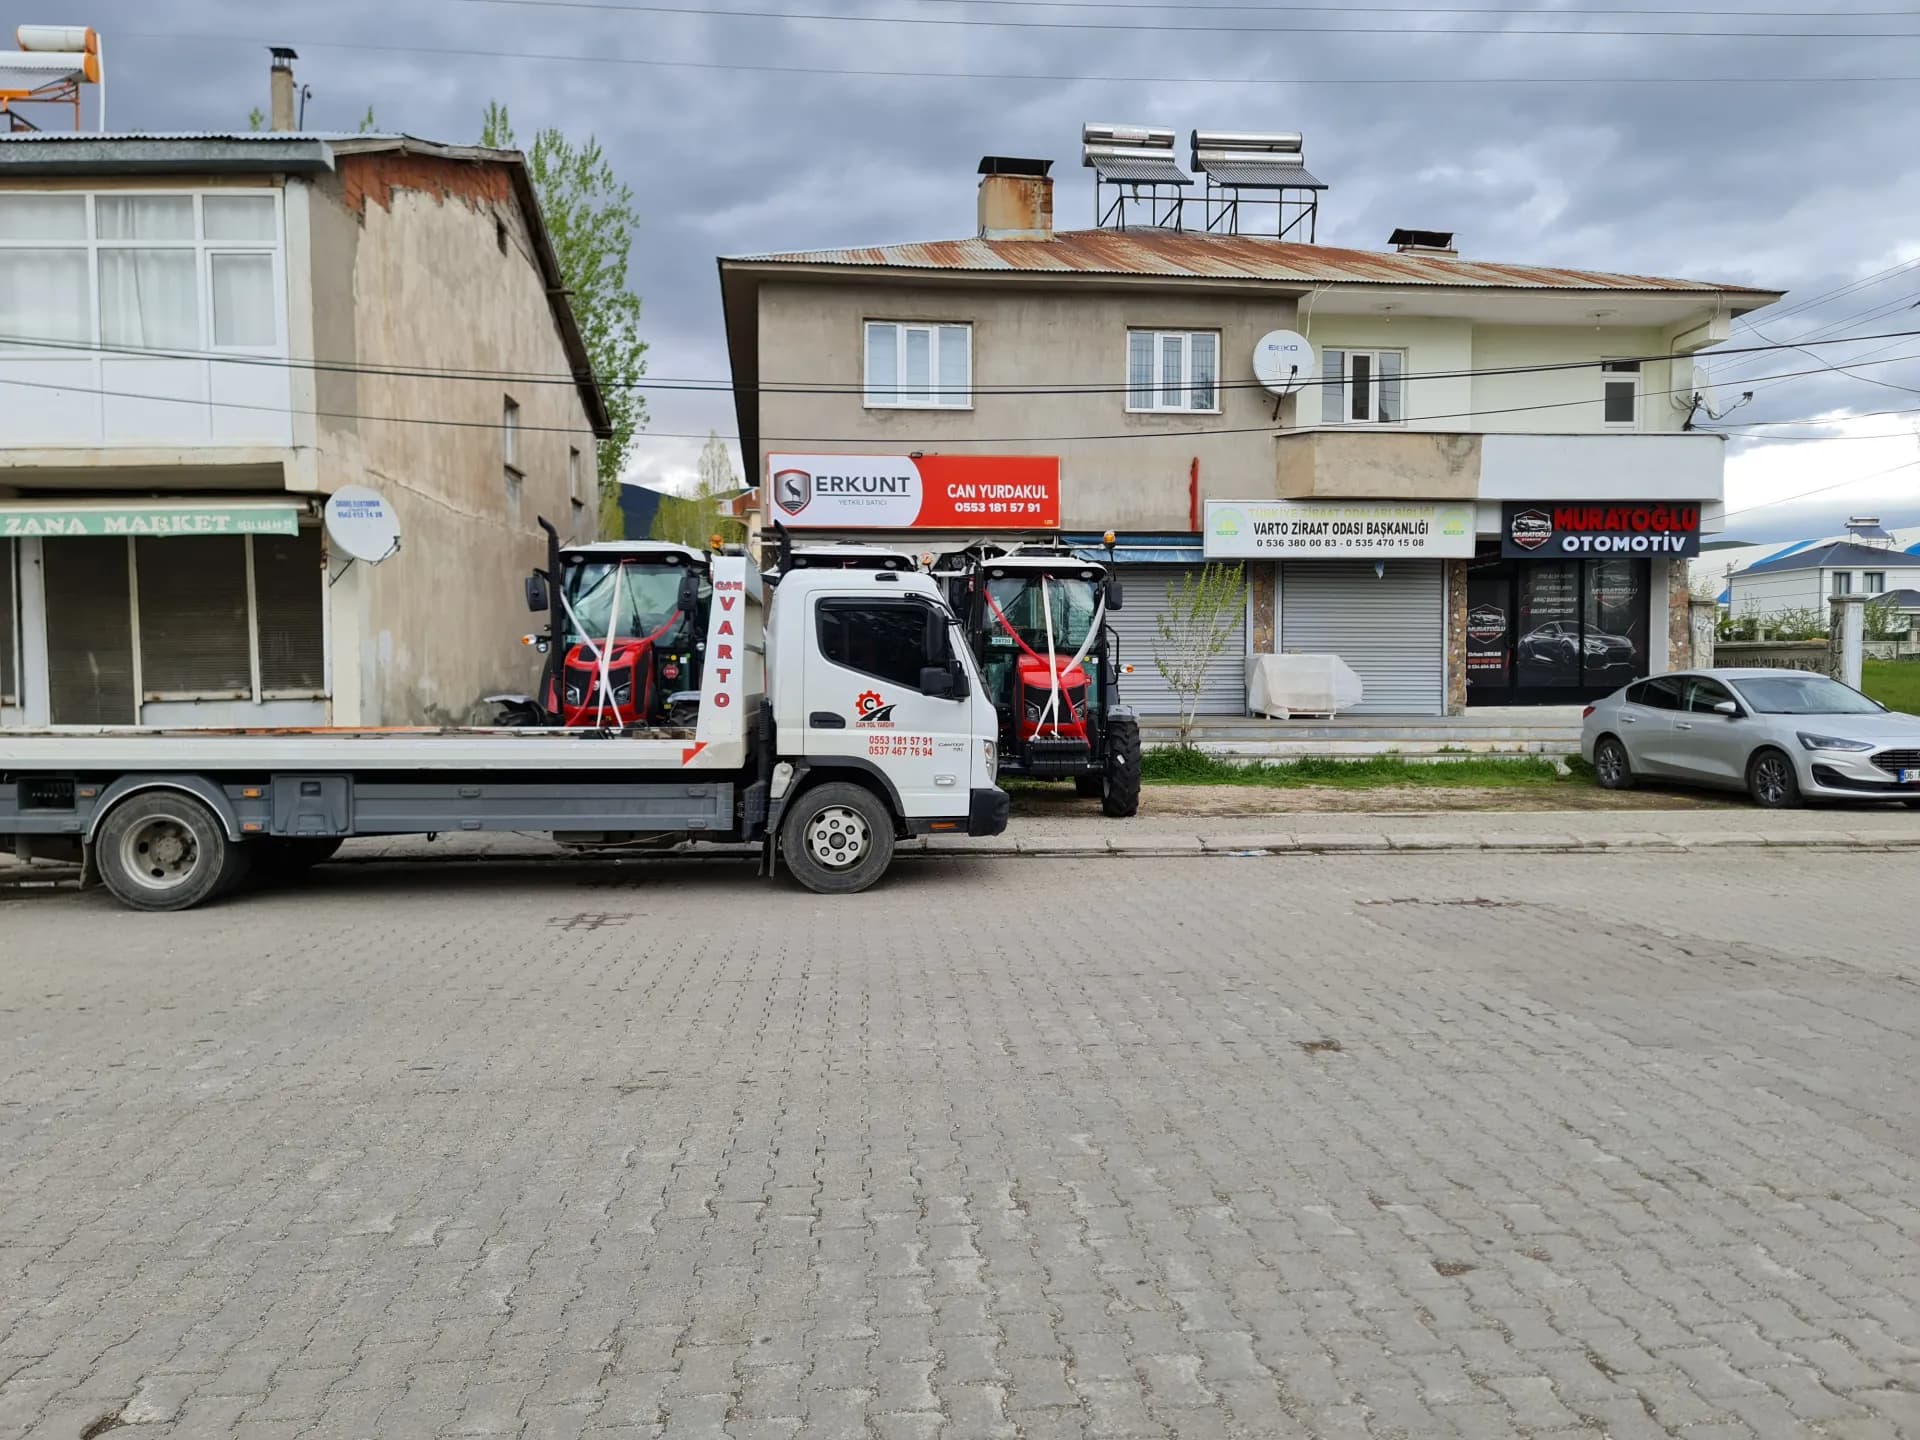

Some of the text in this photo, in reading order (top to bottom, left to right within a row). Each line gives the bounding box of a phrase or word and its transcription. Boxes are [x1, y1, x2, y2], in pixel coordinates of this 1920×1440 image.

[815, 475, 911, 493] ERKUNT
[947, 483, 1049, 499] CAN YURDAKUL
[954, 502, 1041, 513] 0553 181 57 91
[5, 517, 88, 536] ZANA
[104, 514, 230, 533] MARKET
[1554, 504, 1697, 532] MURATOĞLU
[1253, 519, 1429, 538] VARTO ZİRAAT ODASI BAŞKANLIĞI
[1256, 539, 1263, 547] 0
[1266, 539, 1285, 547] 536
[1288, 539, 1306, 547] 380
[1309, 539, 1322, 547] 00
[1324, 539, 1337, 547] 83
[1346, 539, 1353, 547] 0
[1355, 539, 1374, 547] 535
[1376, 539, 1395, 547] 470
[1398, 539, 1410, 547] 15
[1412, 539, 1425, 547] 08
[1562, 531, 1686, 552] OTOMOTİV
[714, 596, 736, 707] VARTO
[863, 698, 876, 710] C
[869, 736, 933, 745] 0553 181 57 91
[869, 746, 933, 756] 0537 467 76 94
